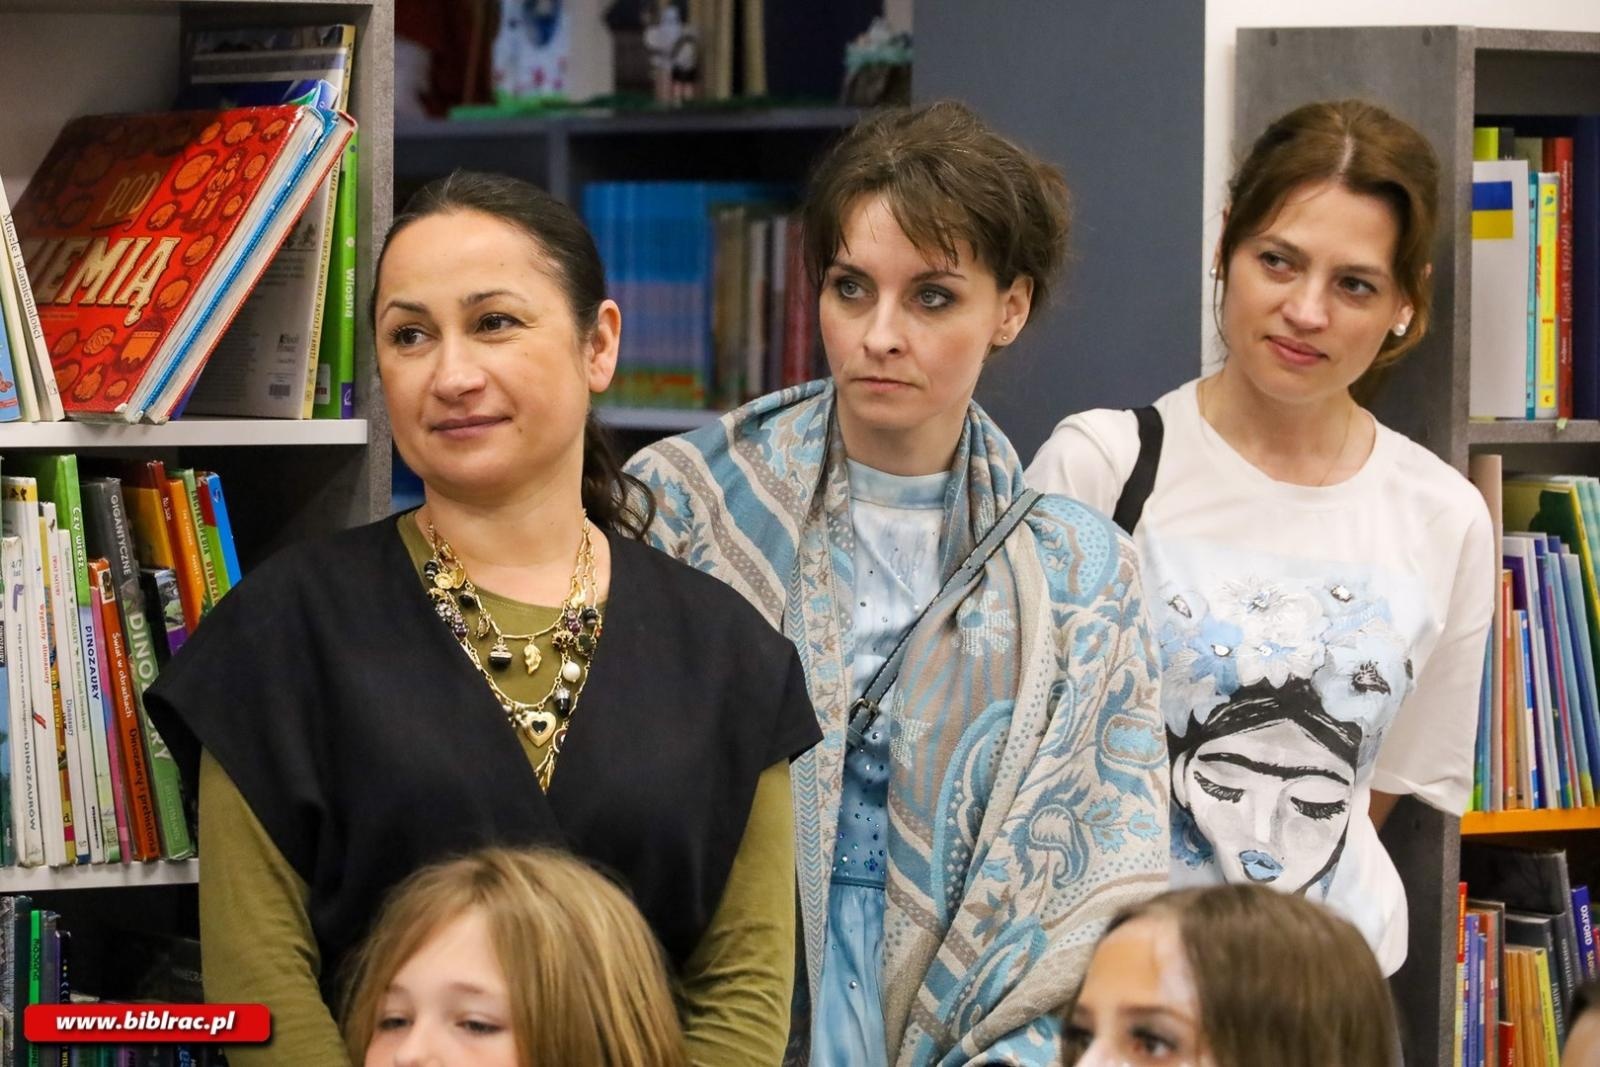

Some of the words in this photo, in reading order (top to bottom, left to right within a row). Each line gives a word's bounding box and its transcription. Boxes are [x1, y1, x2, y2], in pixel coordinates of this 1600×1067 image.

[98, 171, 163, 223] POD
[3, 213, 19, 252] Muszle
[15, 262, 43, 340] skamieniałości
[343, 267, 355, 318] Wiosna
[72, 506, 82, 531] Czy
[110, 494, 131, 576] GIGANTYCZNE
[41, 644, 50, 685] dinozaury
[85, 626, 99, 700] DINOZAURY
[111, 631, 122, 657] Świat
[116, 659, 123, 668] w
[66, 698, 75, 736] Dinozaury
[119, 670, 134, 718] obrazkach
[129, 727, 144, 786] Dinozaury
[24, 742, 37, 832] DINOZAURÓW
[139, 793, 158, 854] prehistoria
[1580, 904, 1593, 946] OXFORD
